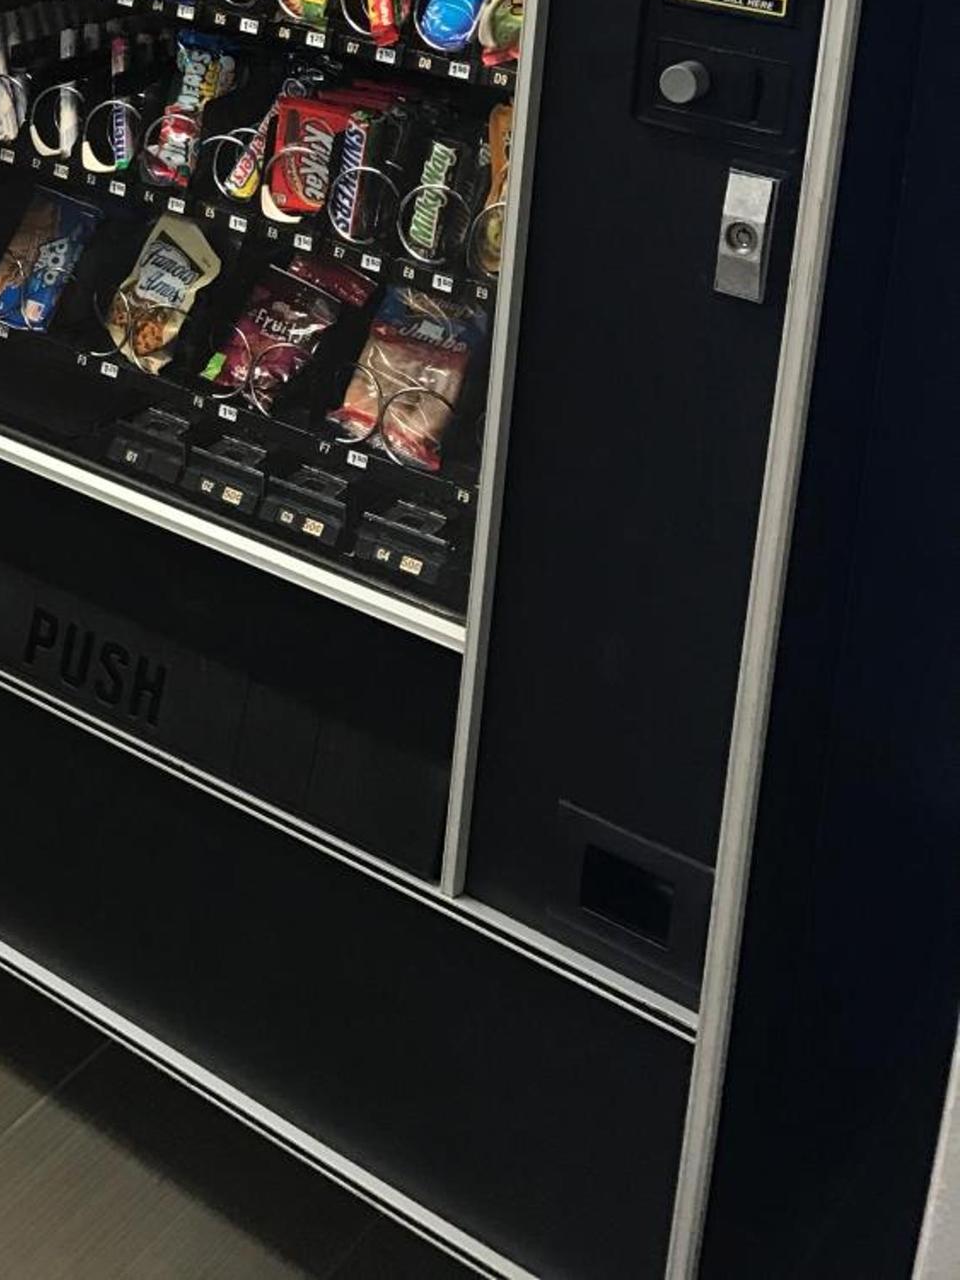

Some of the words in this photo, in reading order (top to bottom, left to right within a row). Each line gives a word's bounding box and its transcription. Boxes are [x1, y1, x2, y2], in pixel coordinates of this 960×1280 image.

[420, 140, 456, 191] Way
[410, 184, 447, 248] Milky
[23, 606, 167, 728] PUSH
